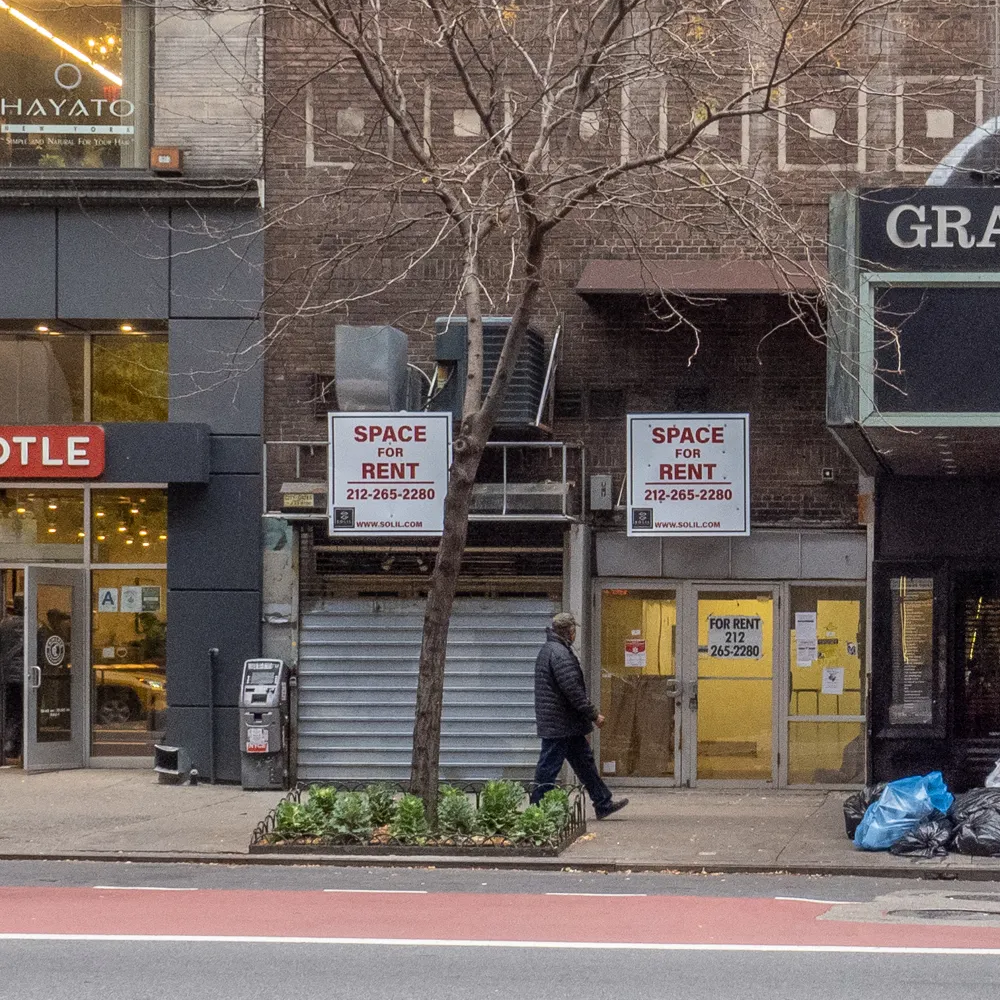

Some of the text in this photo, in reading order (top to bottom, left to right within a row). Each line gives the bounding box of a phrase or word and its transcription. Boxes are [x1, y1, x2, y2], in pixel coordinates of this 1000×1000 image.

[1, 98, 135, 117] HAYATO
[354, 425, 427, 443] SPACE
[651, 426, 725, 444] SPACE
[377, 447, 404, 458] FOR
[675, 448, 701, 459] FOR
[361, 462, 420, 480] RENT
[659, 463, 717, 480] RENT
[346, 488, 435, 500] 212-265-2280
[644, 489, 732, 501] 212-265-2280
[654, 521, 721, 529] WWW.SOLIL.COM
[101, 591, 115, 605] A
[709, 618, 760, 630] FOR RENT
[715, 632, 745, 644] 212
[710, 645, 760, 657] 265-2280
